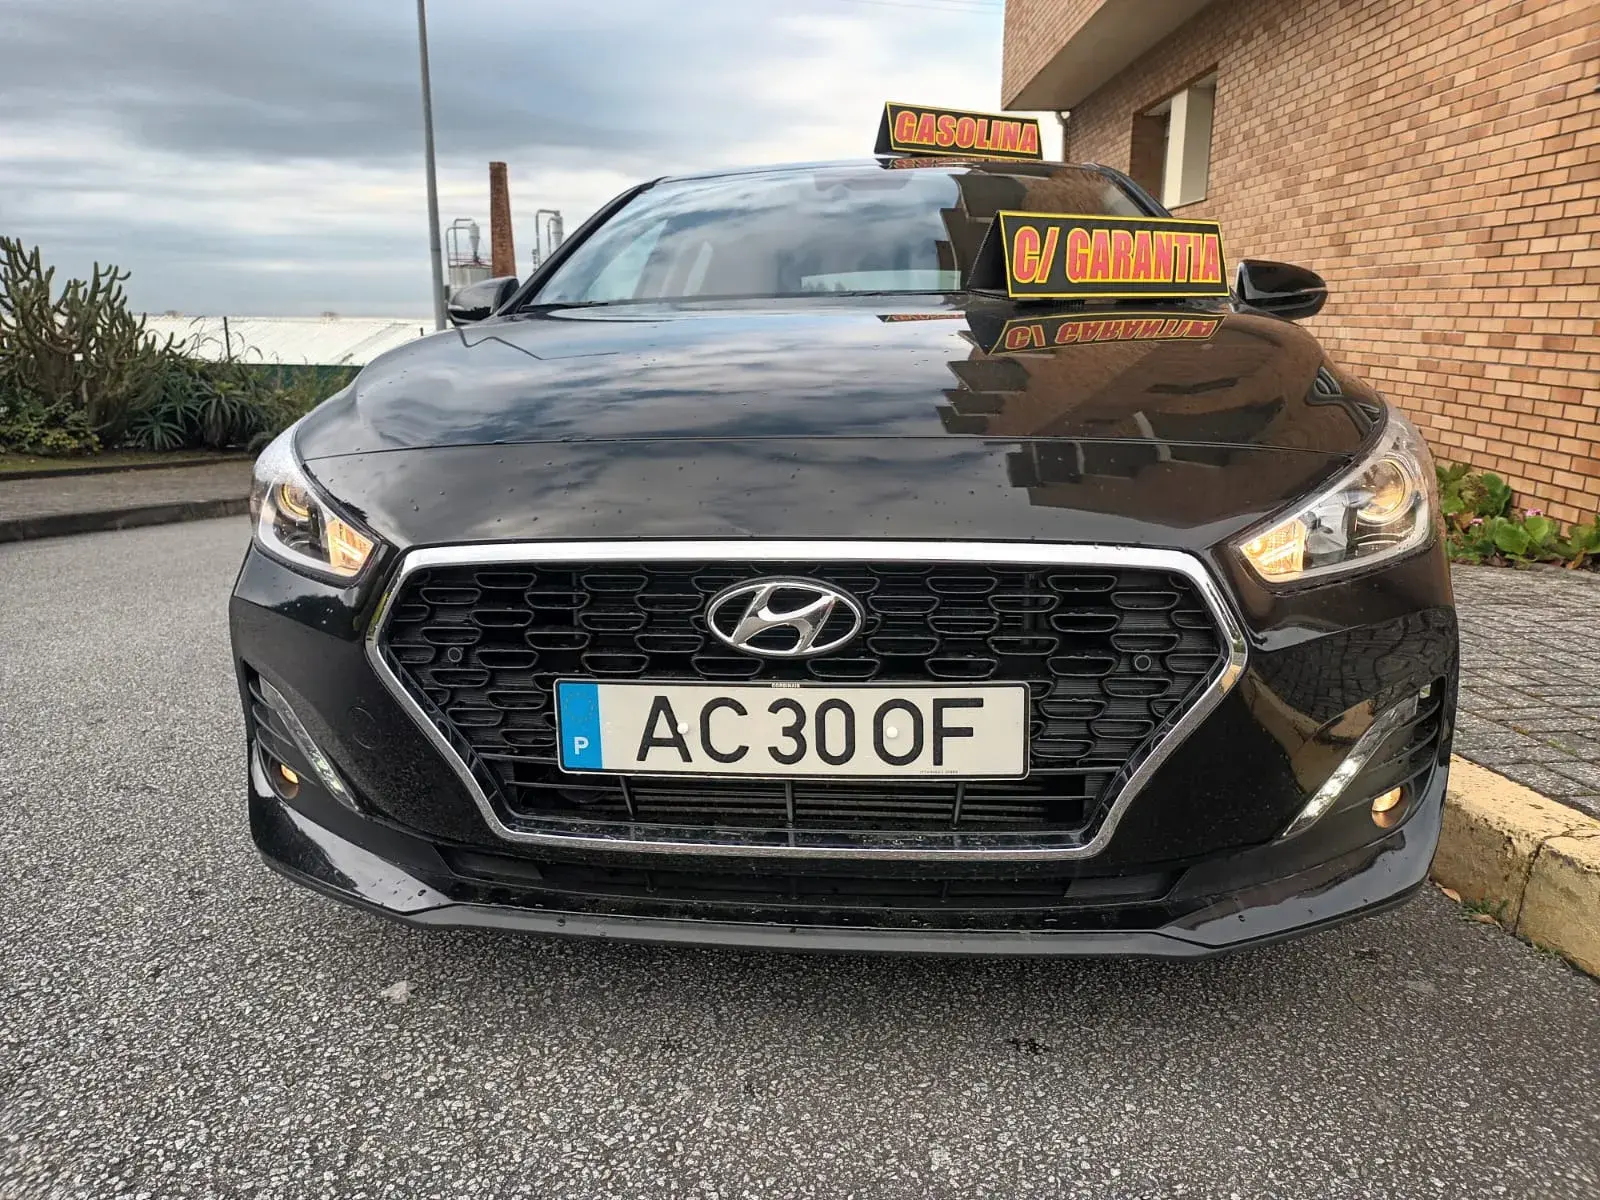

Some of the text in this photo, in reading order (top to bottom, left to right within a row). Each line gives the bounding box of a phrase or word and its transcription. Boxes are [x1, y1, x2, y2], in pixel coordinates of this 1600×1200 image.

[894, 111, 1039, 154] GASOLINA
[1013, 226, 1222, 283] C/ GARANTIA
[574, 736, 589, 755] P
[636, 695, 984, 766] AC 30 OF
